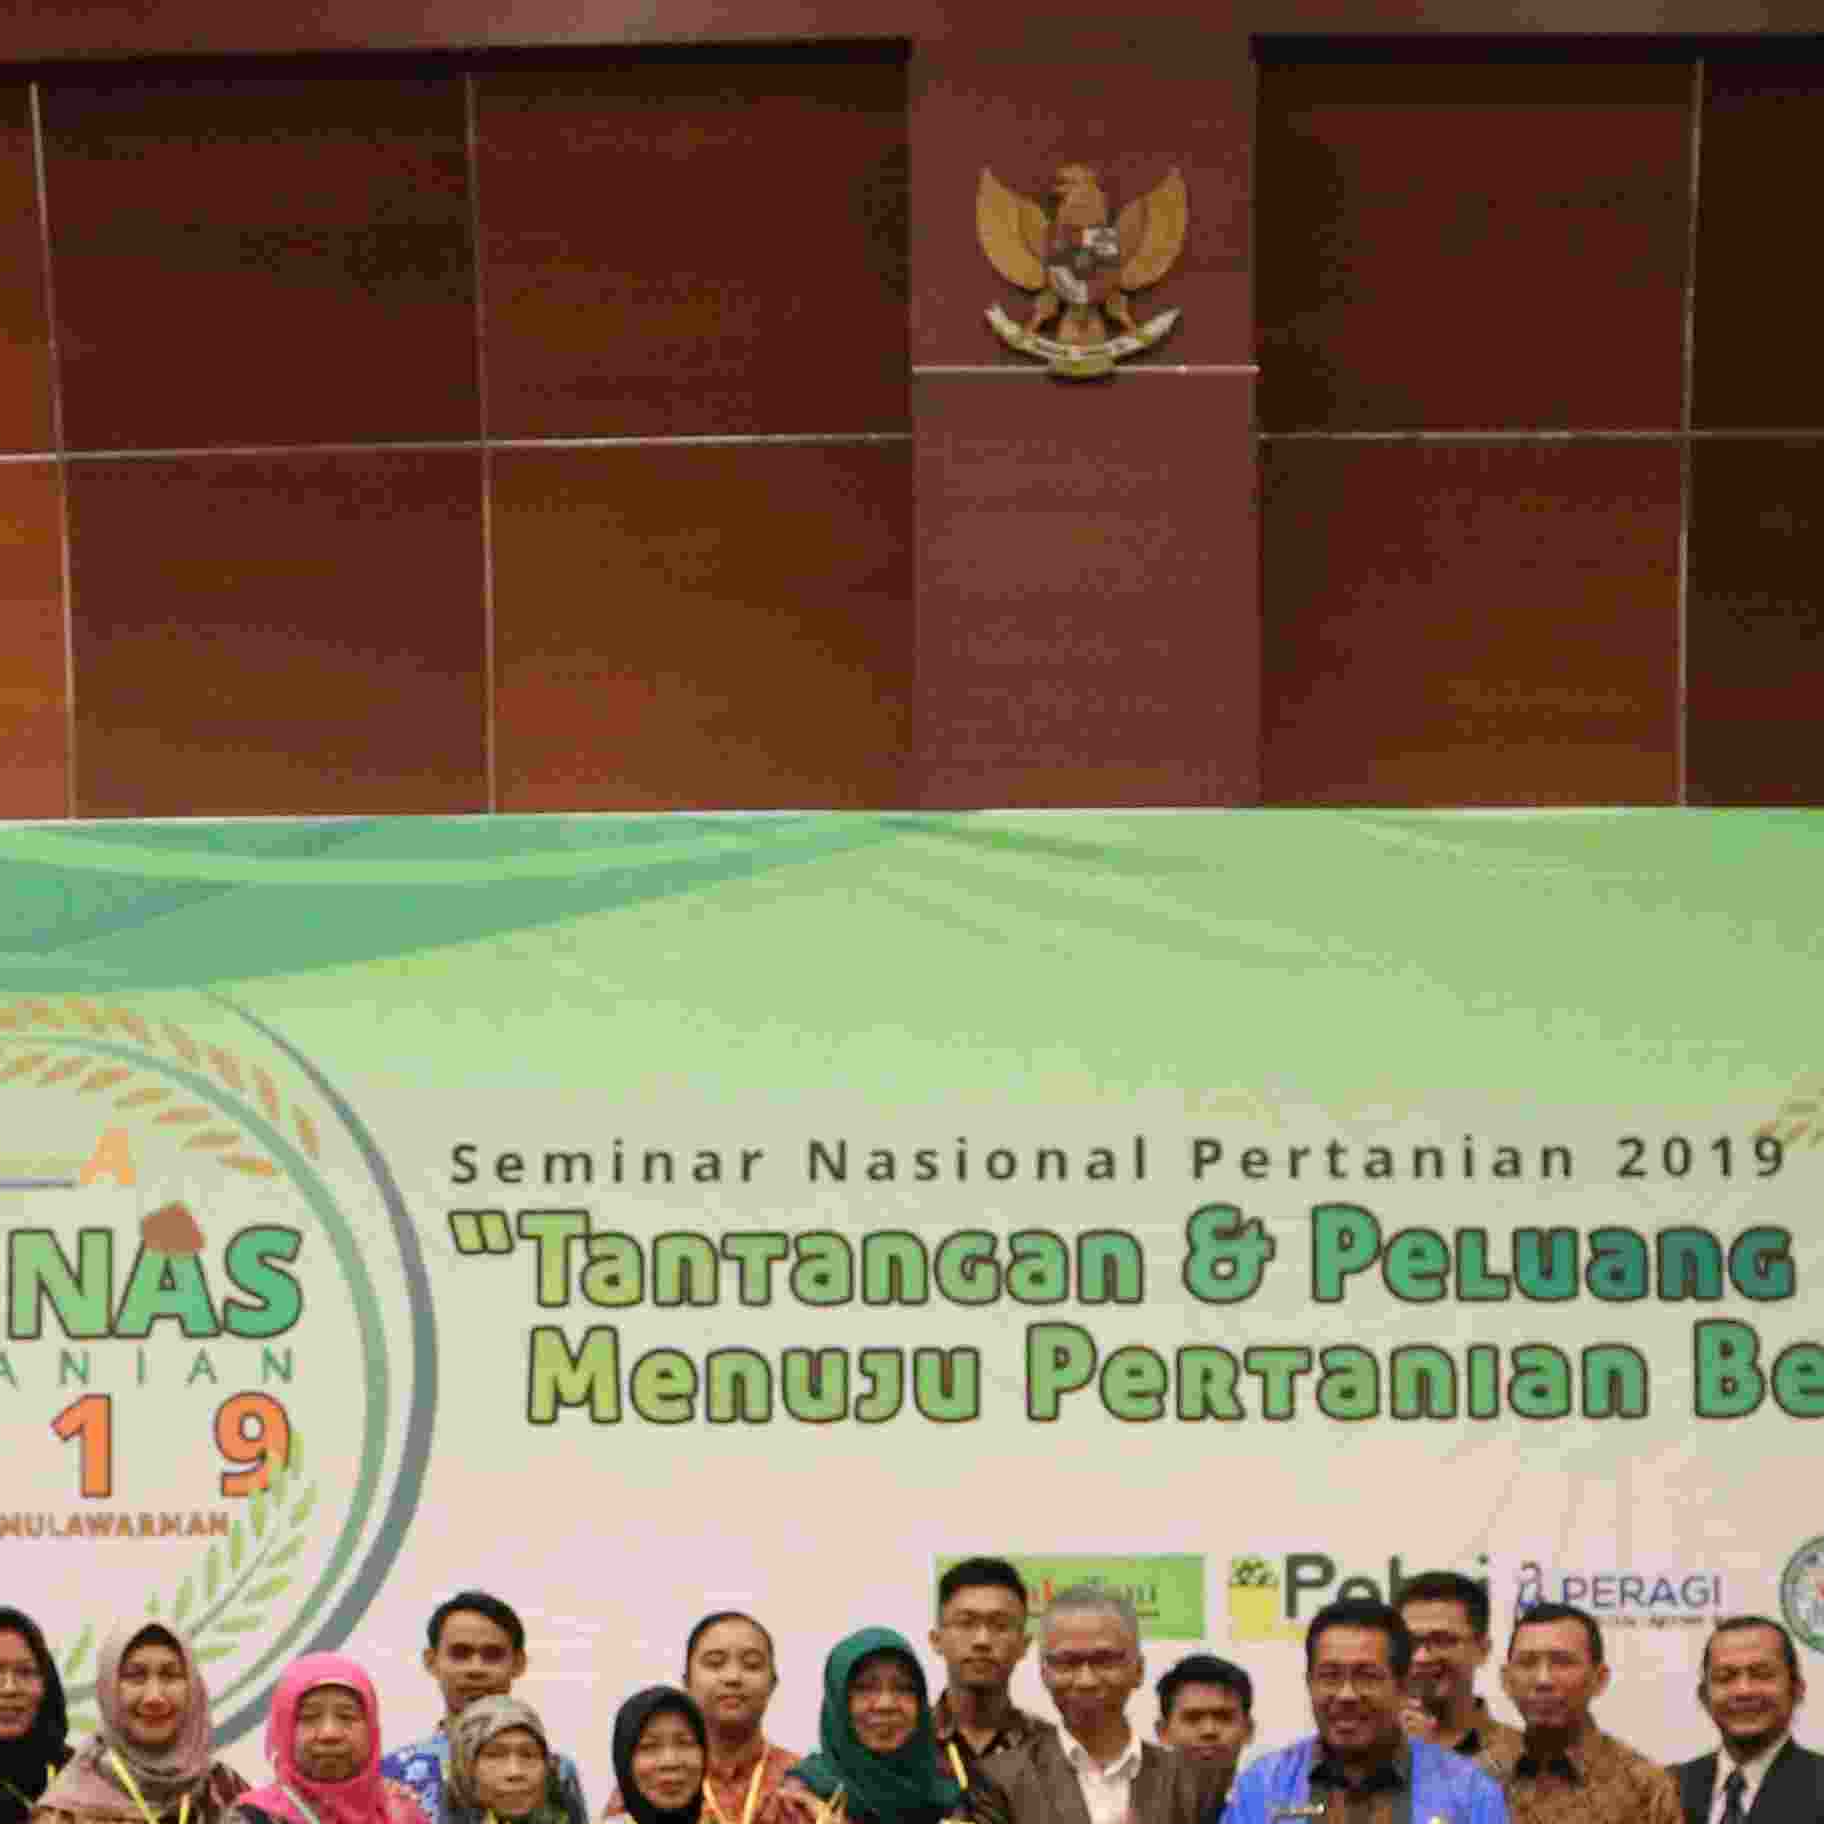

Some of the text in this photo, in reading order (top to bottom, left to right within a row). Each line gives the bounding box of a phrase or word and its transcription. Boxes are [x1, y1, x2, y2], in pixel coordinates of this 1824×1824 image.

[450, 1134, 1785, 1185] Seminar Nasional Pertanian 2019
[1180, 1202, 1276, 1304] &
[1562, 1575, 1723, 1608] PERAGI
